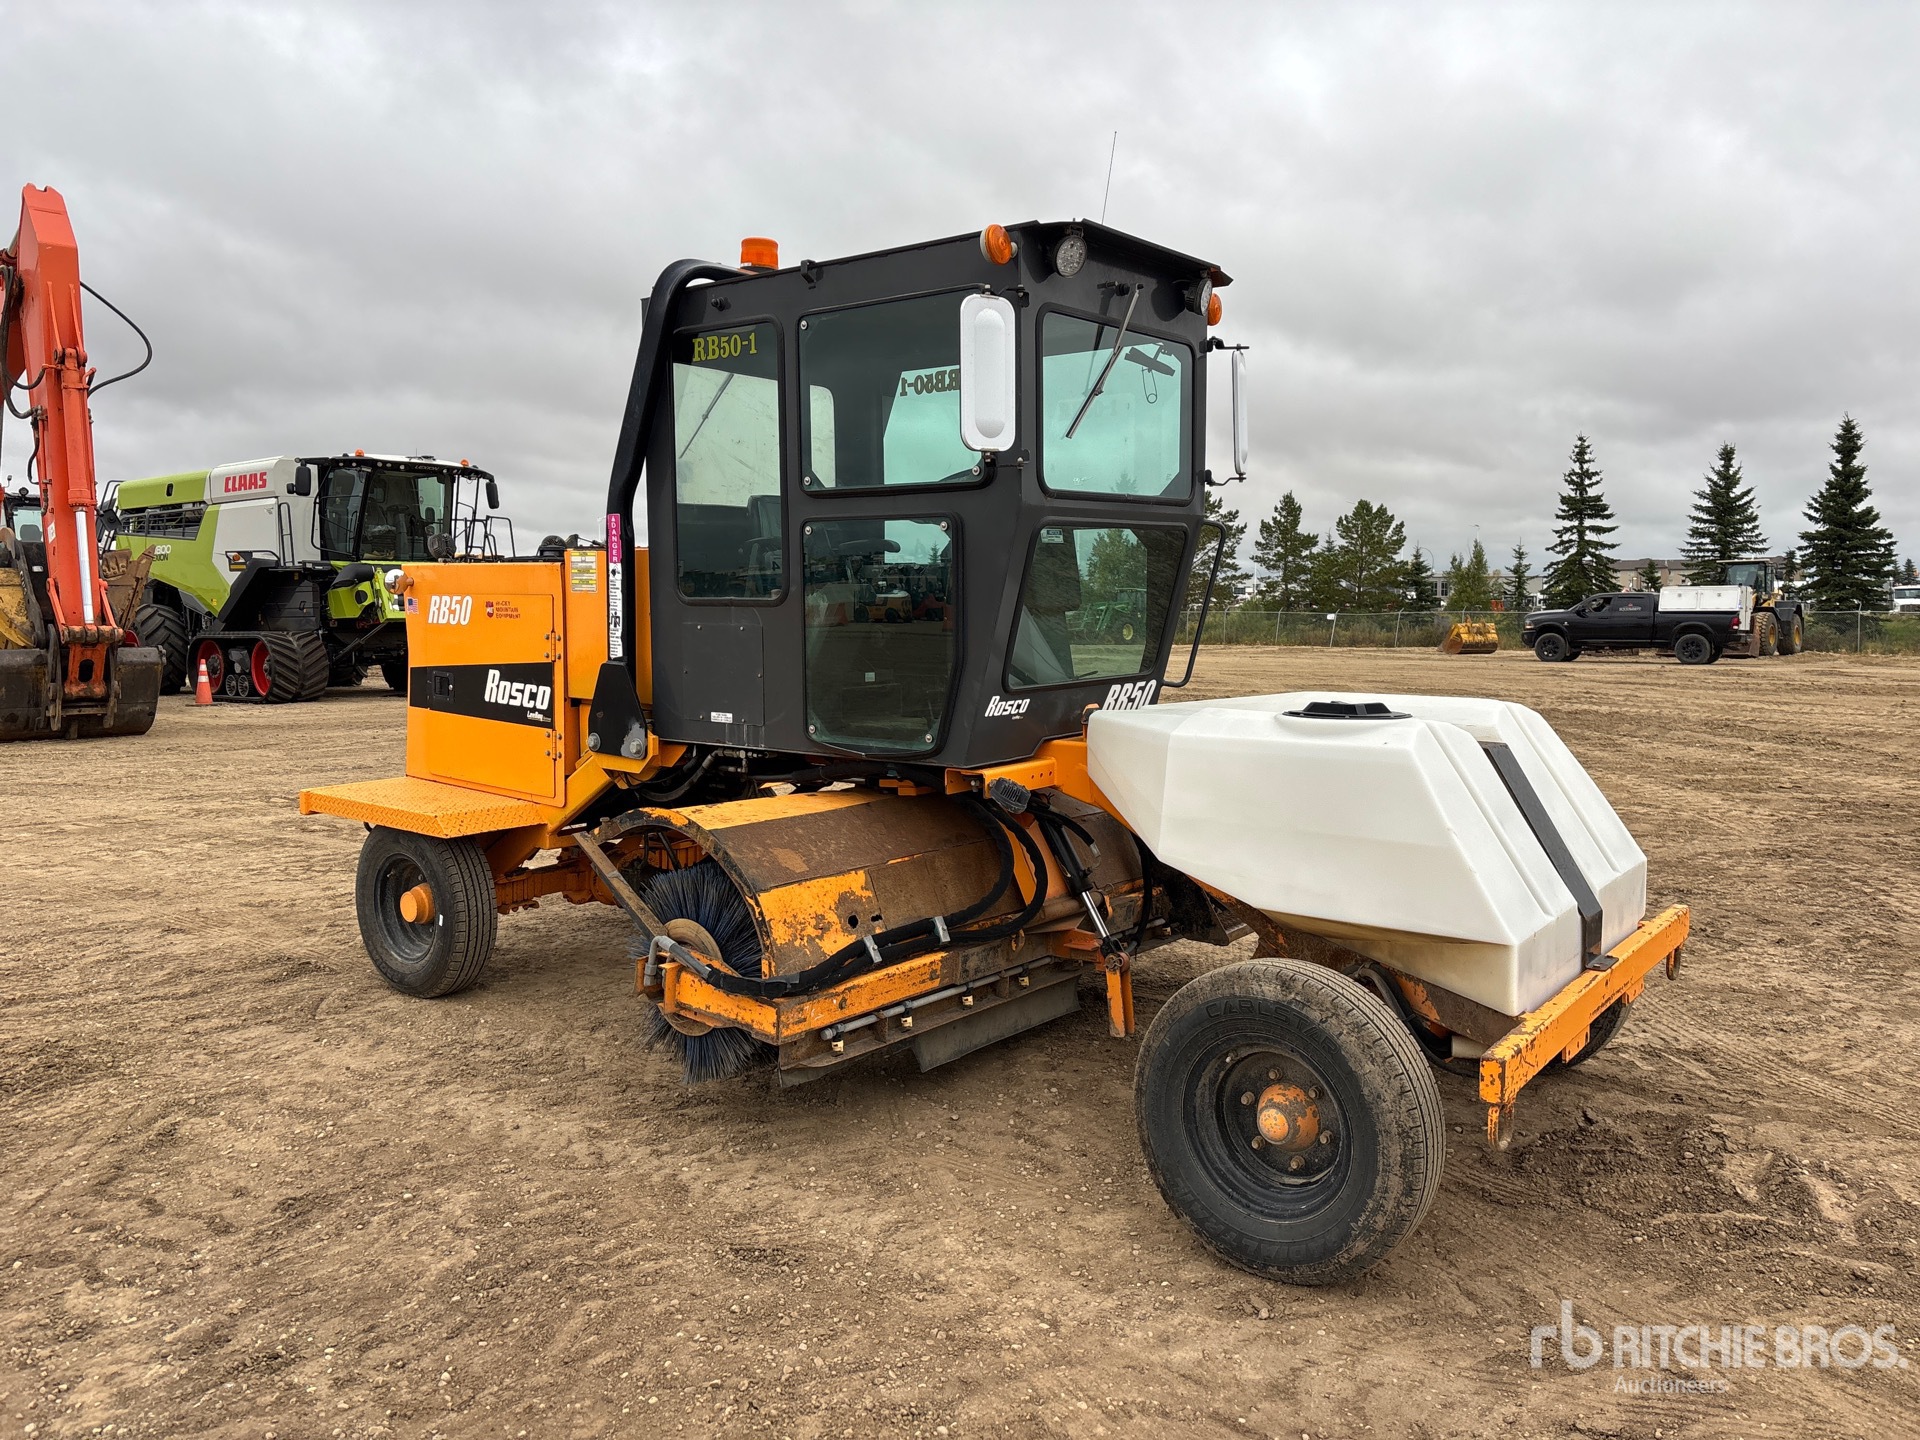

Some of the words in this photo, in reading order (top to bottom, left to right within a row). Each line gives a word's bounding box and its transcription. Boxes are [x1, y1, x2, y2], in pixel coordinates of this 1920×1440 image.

[692, 332, 757, 362] RB50-1
[224, 471, 267, 493] CLAAS
[428, 595, 473, 625] RB50
[1102, 679, 1157, 710] RB50
[1205, 1000, 1342, 1054] CARLSTAR
